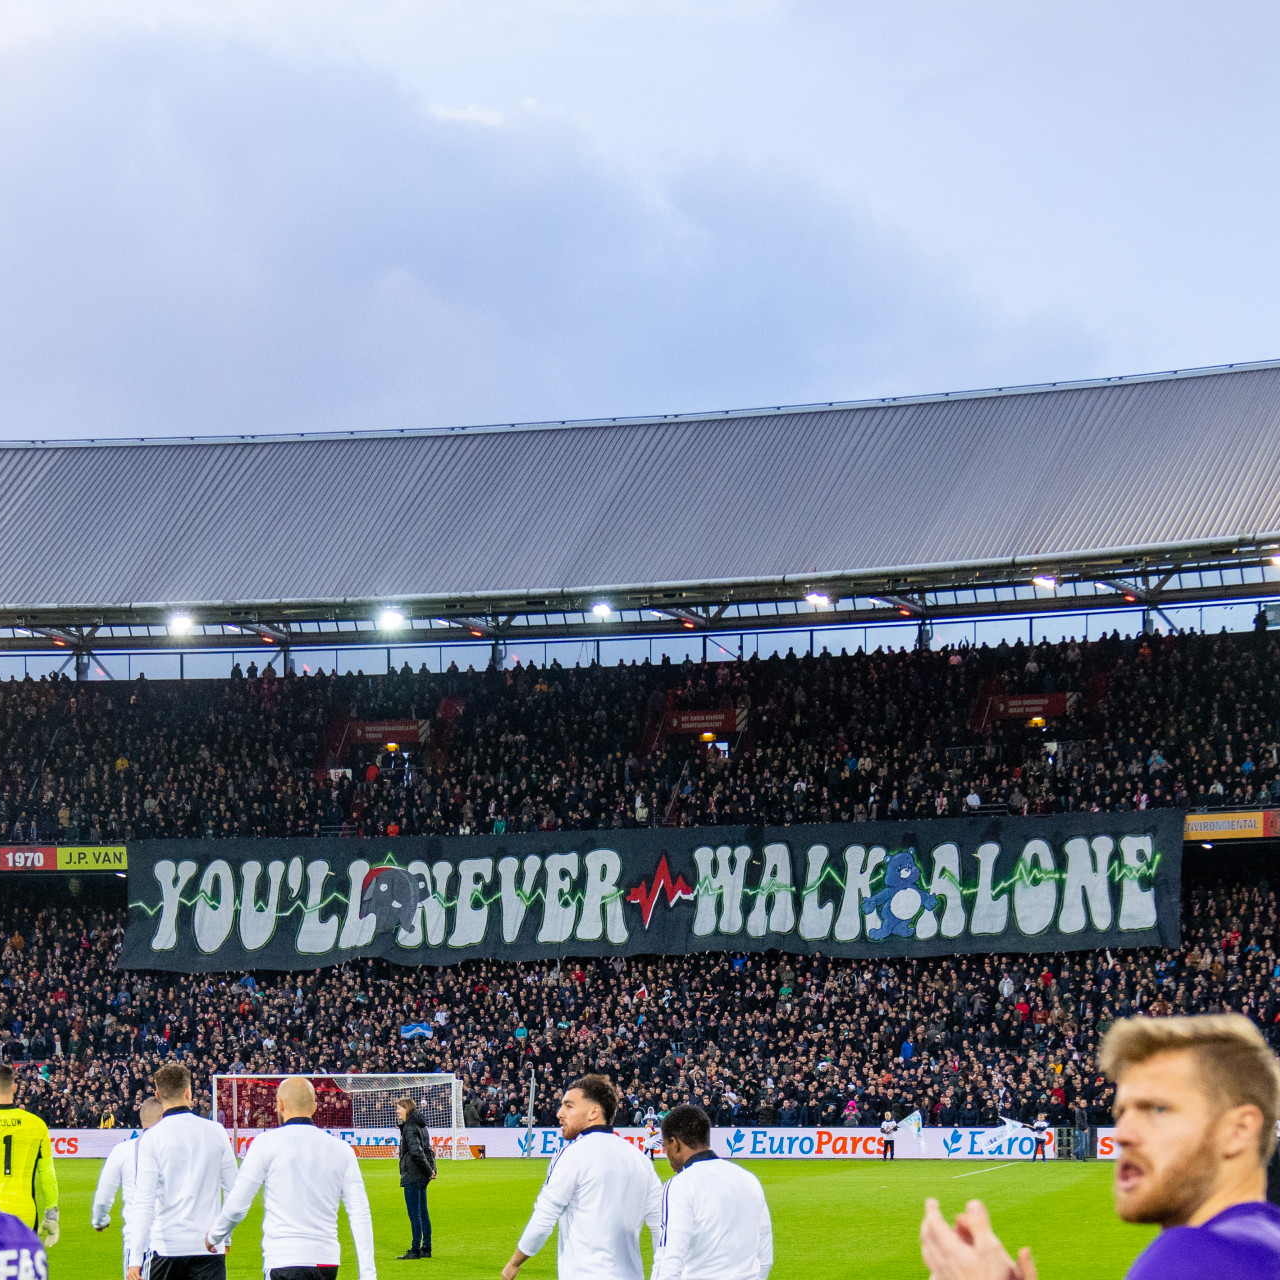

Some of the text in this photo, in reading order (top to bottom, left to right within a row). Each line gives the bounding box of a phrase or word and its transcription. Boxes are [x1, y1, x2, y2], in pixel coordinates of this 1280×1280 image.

[6, 852, 44, 867] 1970
[65, 852, 88, 865] J.P.
[151, 834, 1158, 953] YOU'LL NEVER WALK ALONE
[3, 1135, 13, 1176] 1
[750, 1130, 886, 1156] EuroParcs
